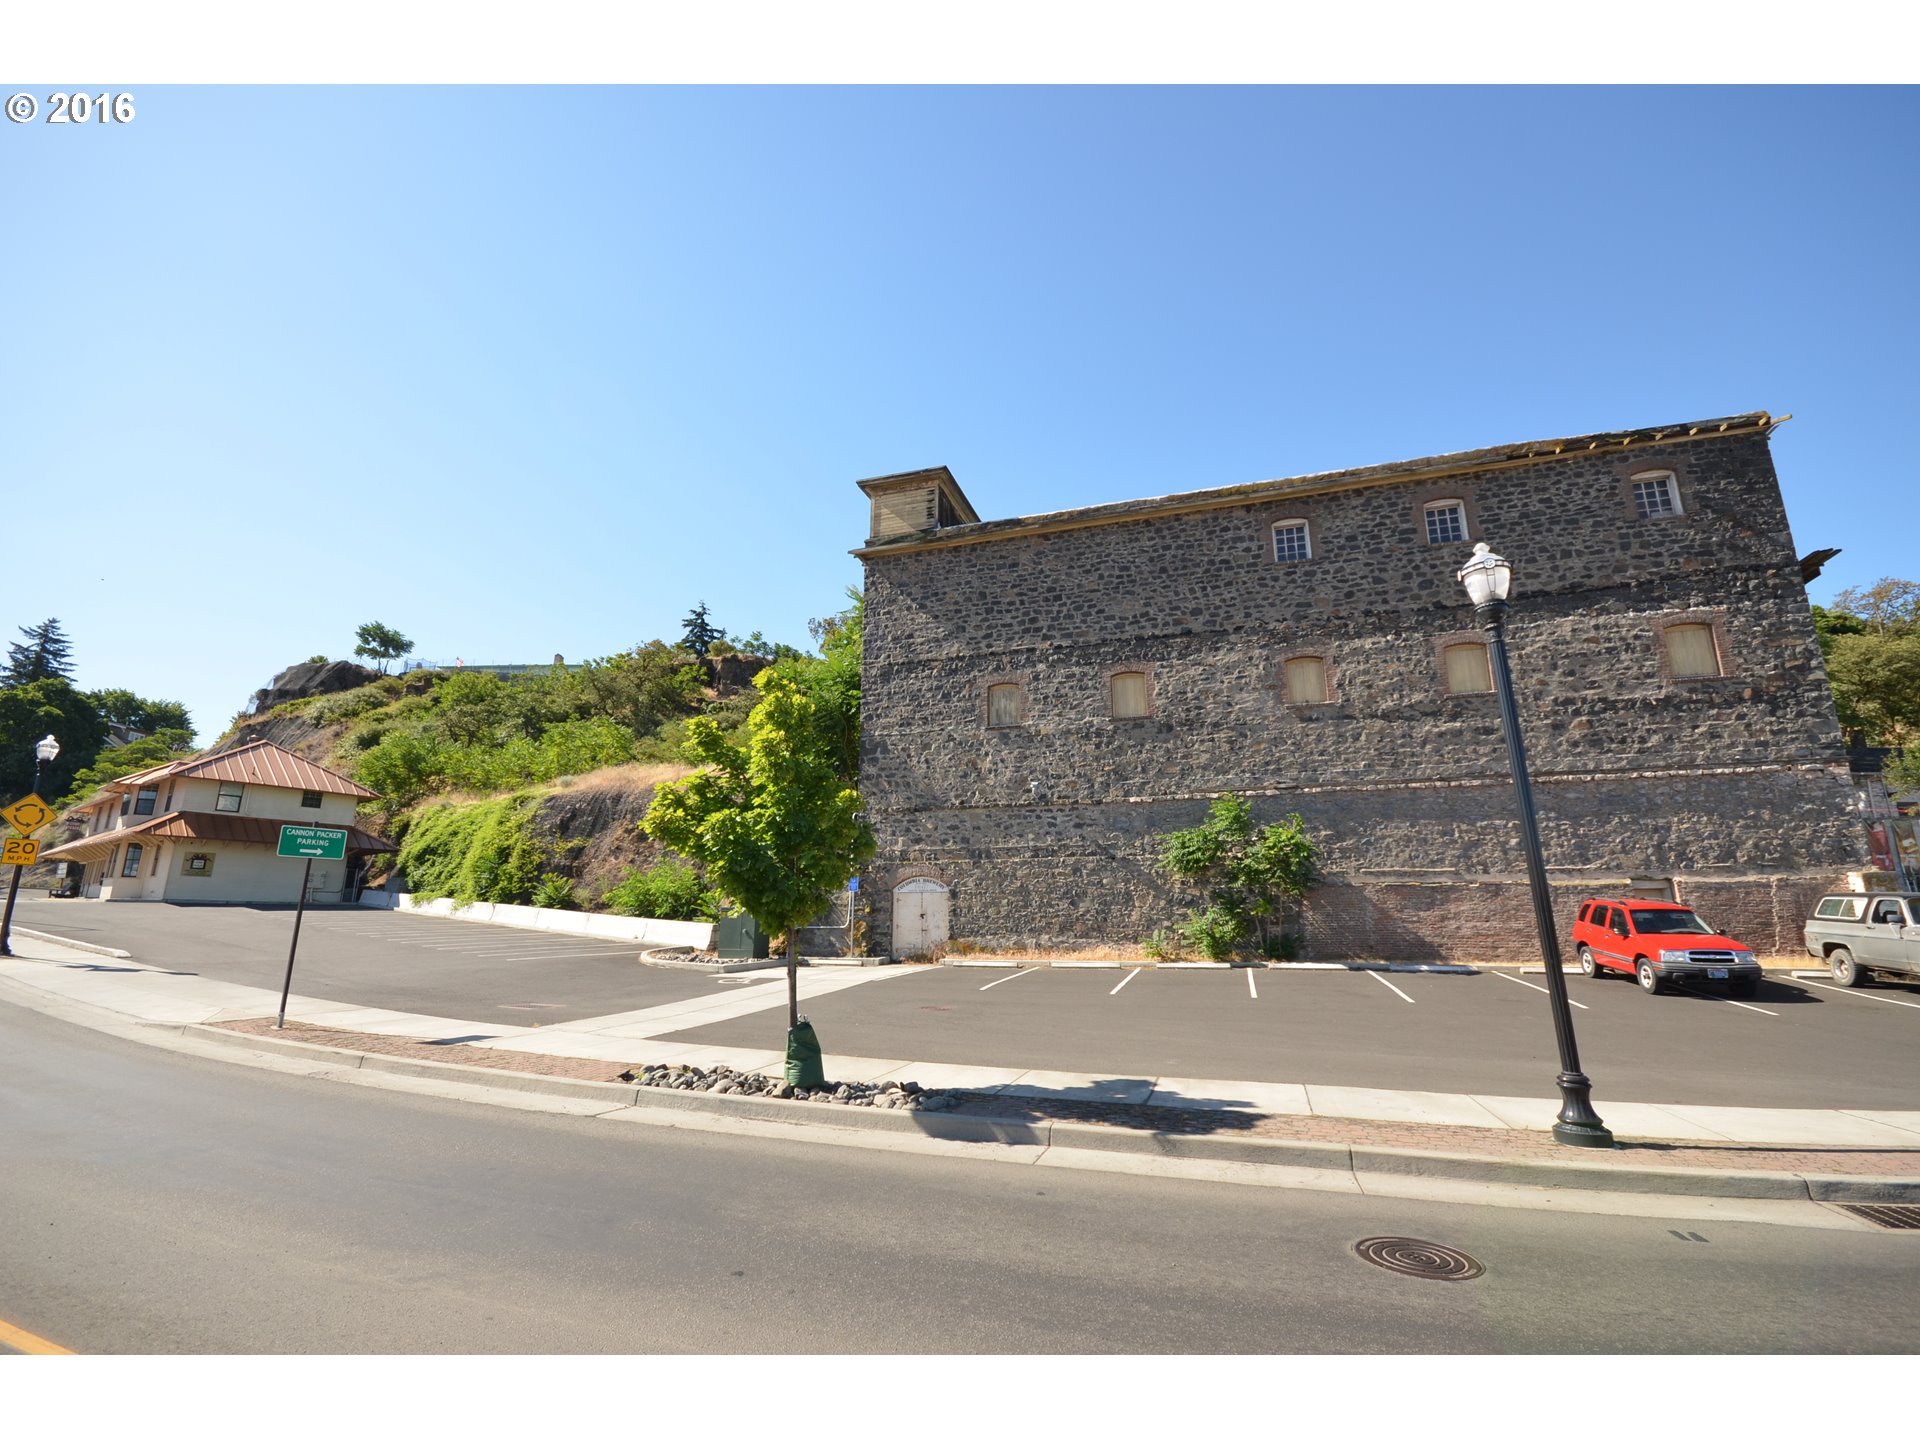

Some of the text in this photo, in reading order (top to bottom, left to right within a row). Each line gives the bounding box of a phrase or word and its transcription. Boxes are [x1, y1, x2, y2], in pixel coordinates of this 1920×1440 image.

[286, 828, 342, 839] CANNON PACKER
[7, 841, 35, 854] 20
[297, 838, 329, 847] PARKING
